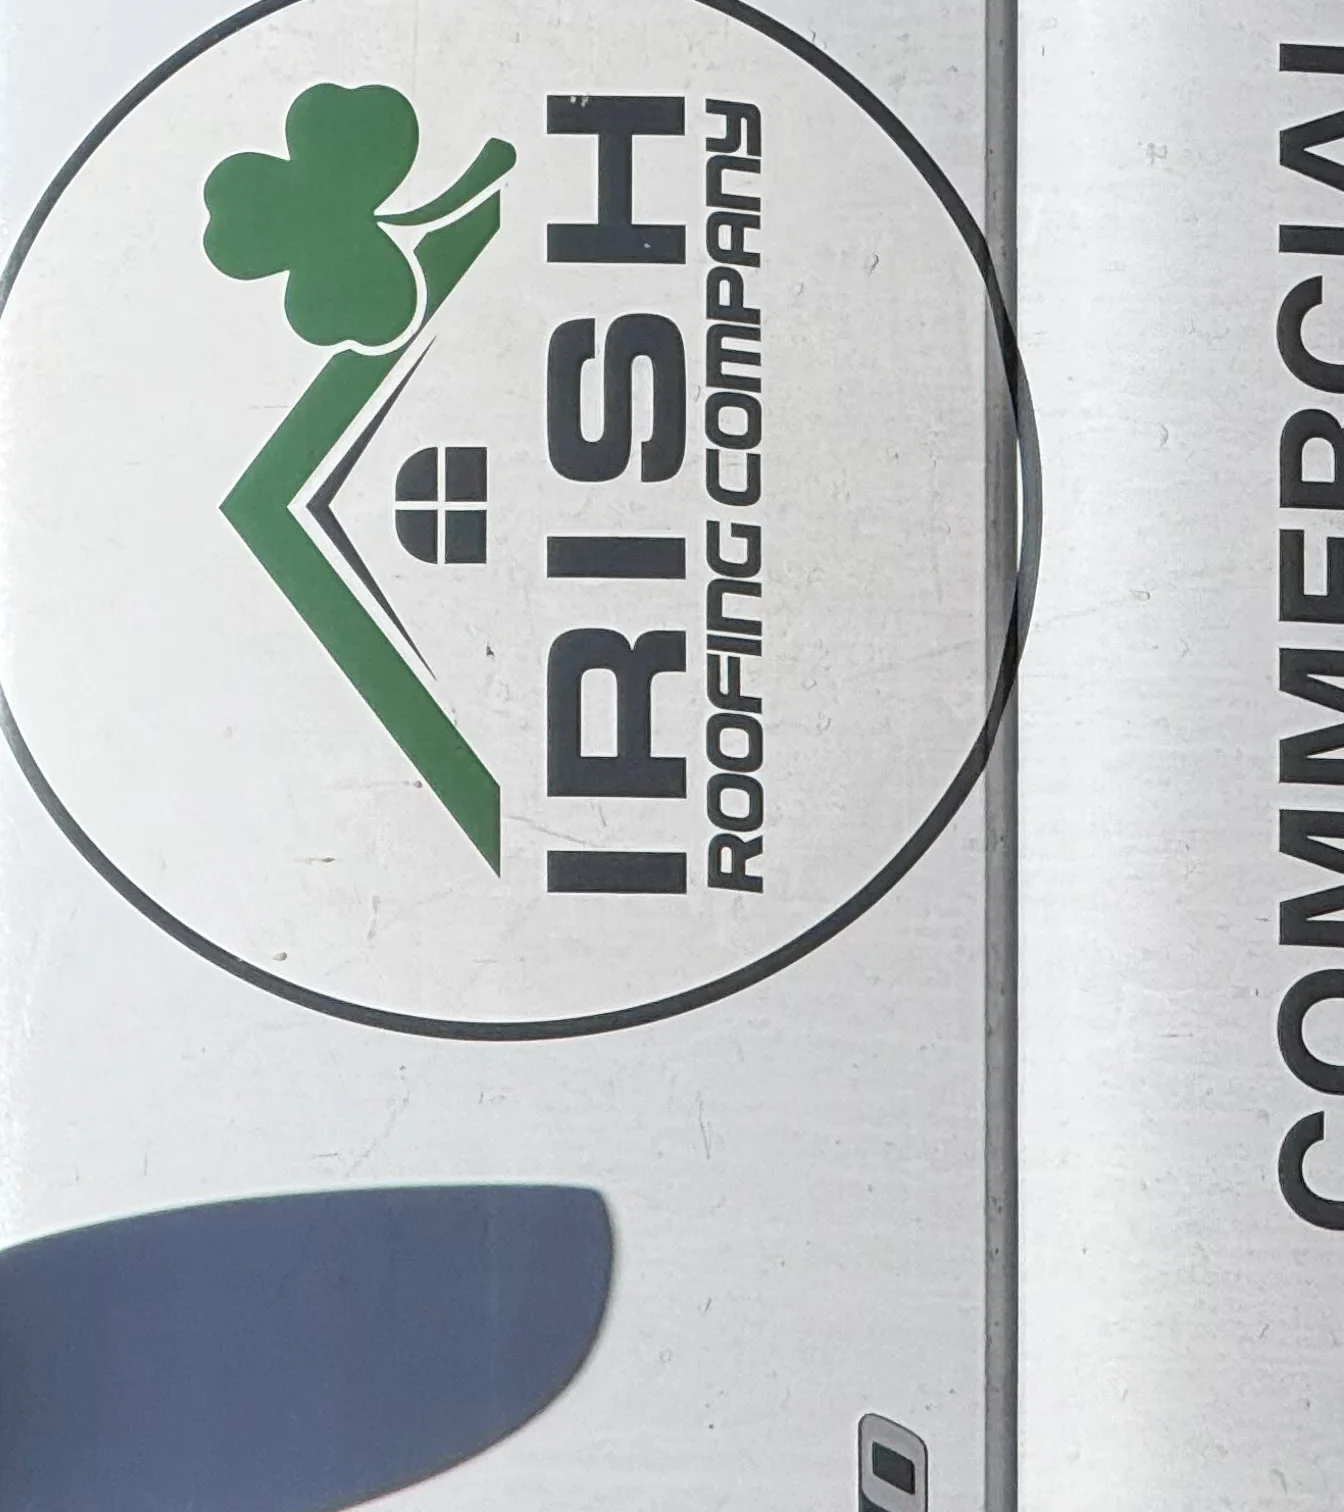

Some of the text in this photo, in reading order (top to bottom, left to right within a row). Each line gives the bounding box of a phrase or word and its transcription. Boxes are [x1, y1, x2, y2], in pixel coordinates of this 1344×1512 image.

[545, 95, 687, 895] IRISH
[706, 99, 764, 893] ROOFING COMPANY
